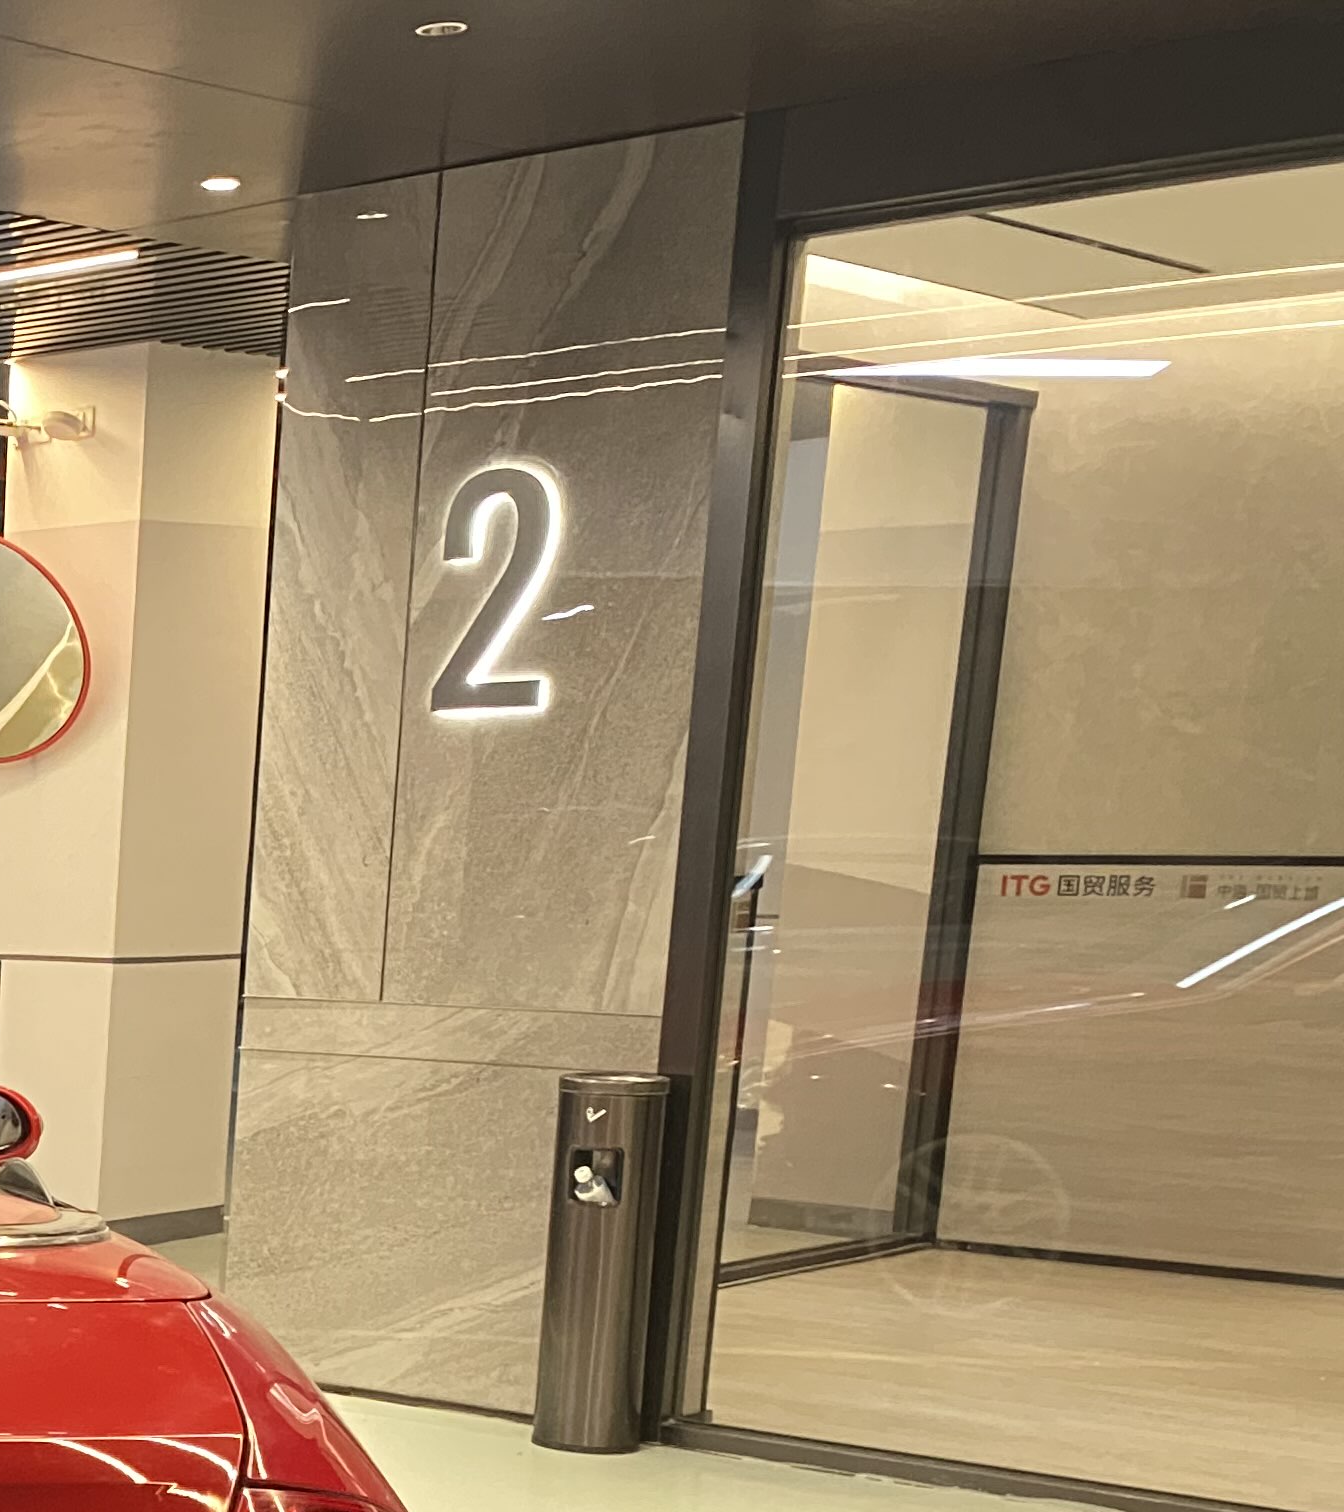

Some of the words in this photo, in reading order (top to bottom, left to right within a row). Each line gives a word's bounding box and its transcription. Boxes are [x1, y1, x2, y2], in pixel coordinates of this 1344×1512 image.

[431, 464, 558, 717] 2
[1000, 874, 1051, 897] ITG
[1056, 874, 1156, 897] 国贸服务
